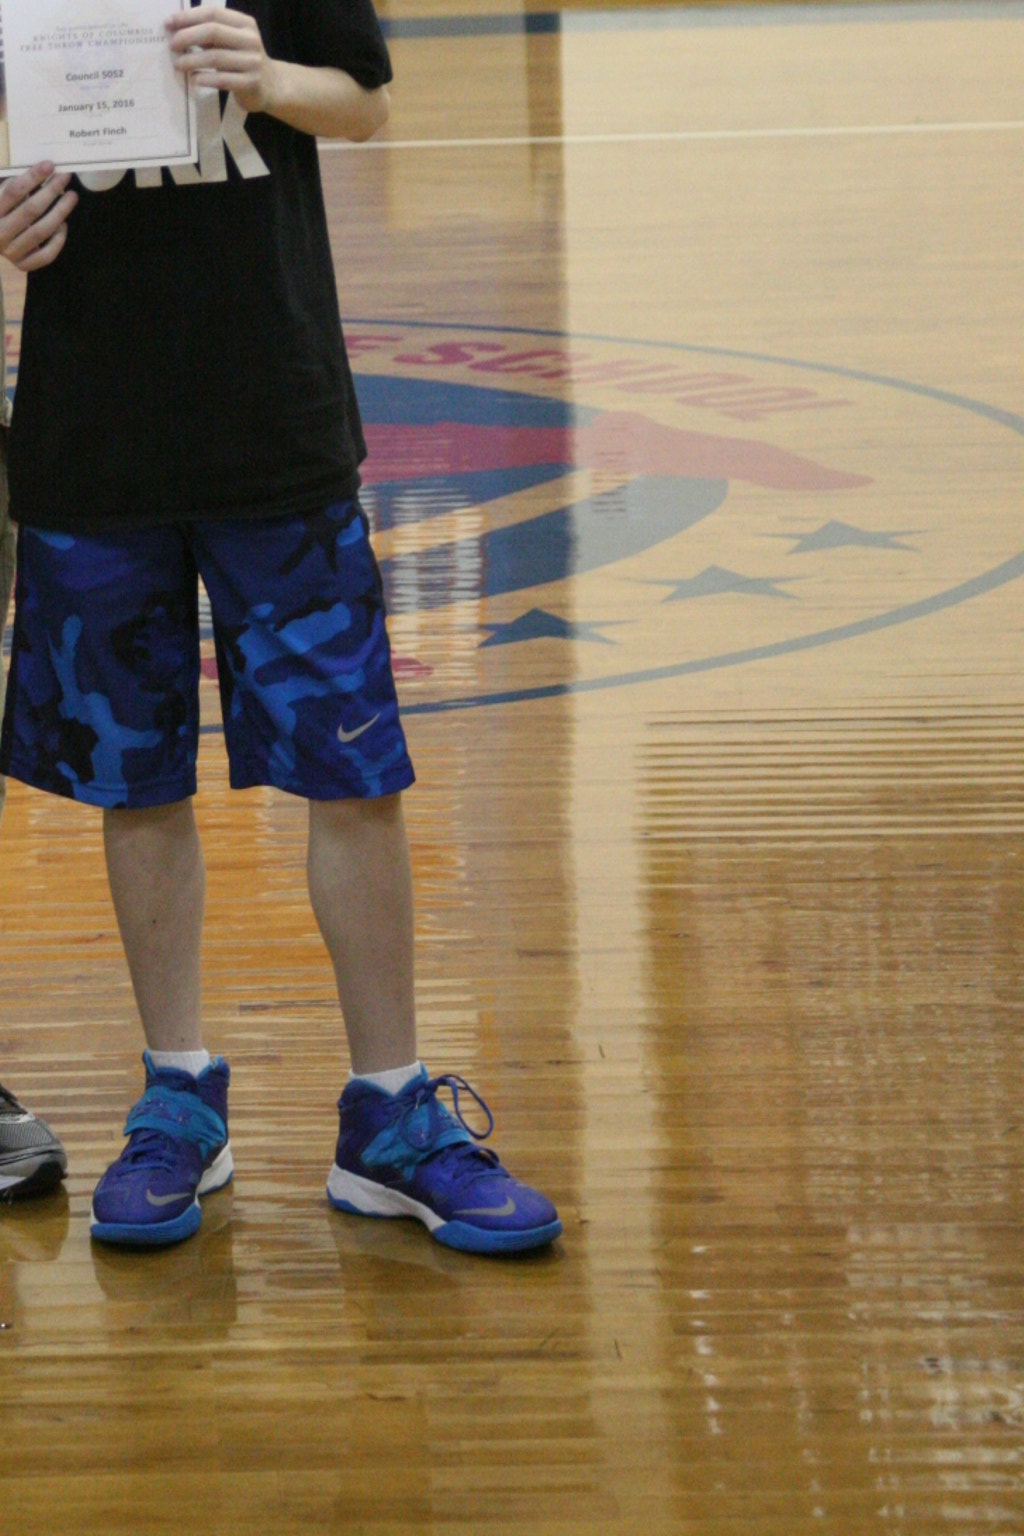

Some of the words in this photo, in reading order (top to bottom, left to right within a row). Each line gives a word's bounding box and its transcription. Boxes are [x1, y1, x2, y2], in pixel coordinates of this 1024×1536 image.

[65, 70, 99, 81] Council
[58, 102, 94, 113] January
[96, 101, 110, 111] 15,
[113, 99, 135, 109] 2016
[69, 128, 100, 138] Robert
[103, 126, 127, 136] Finch
